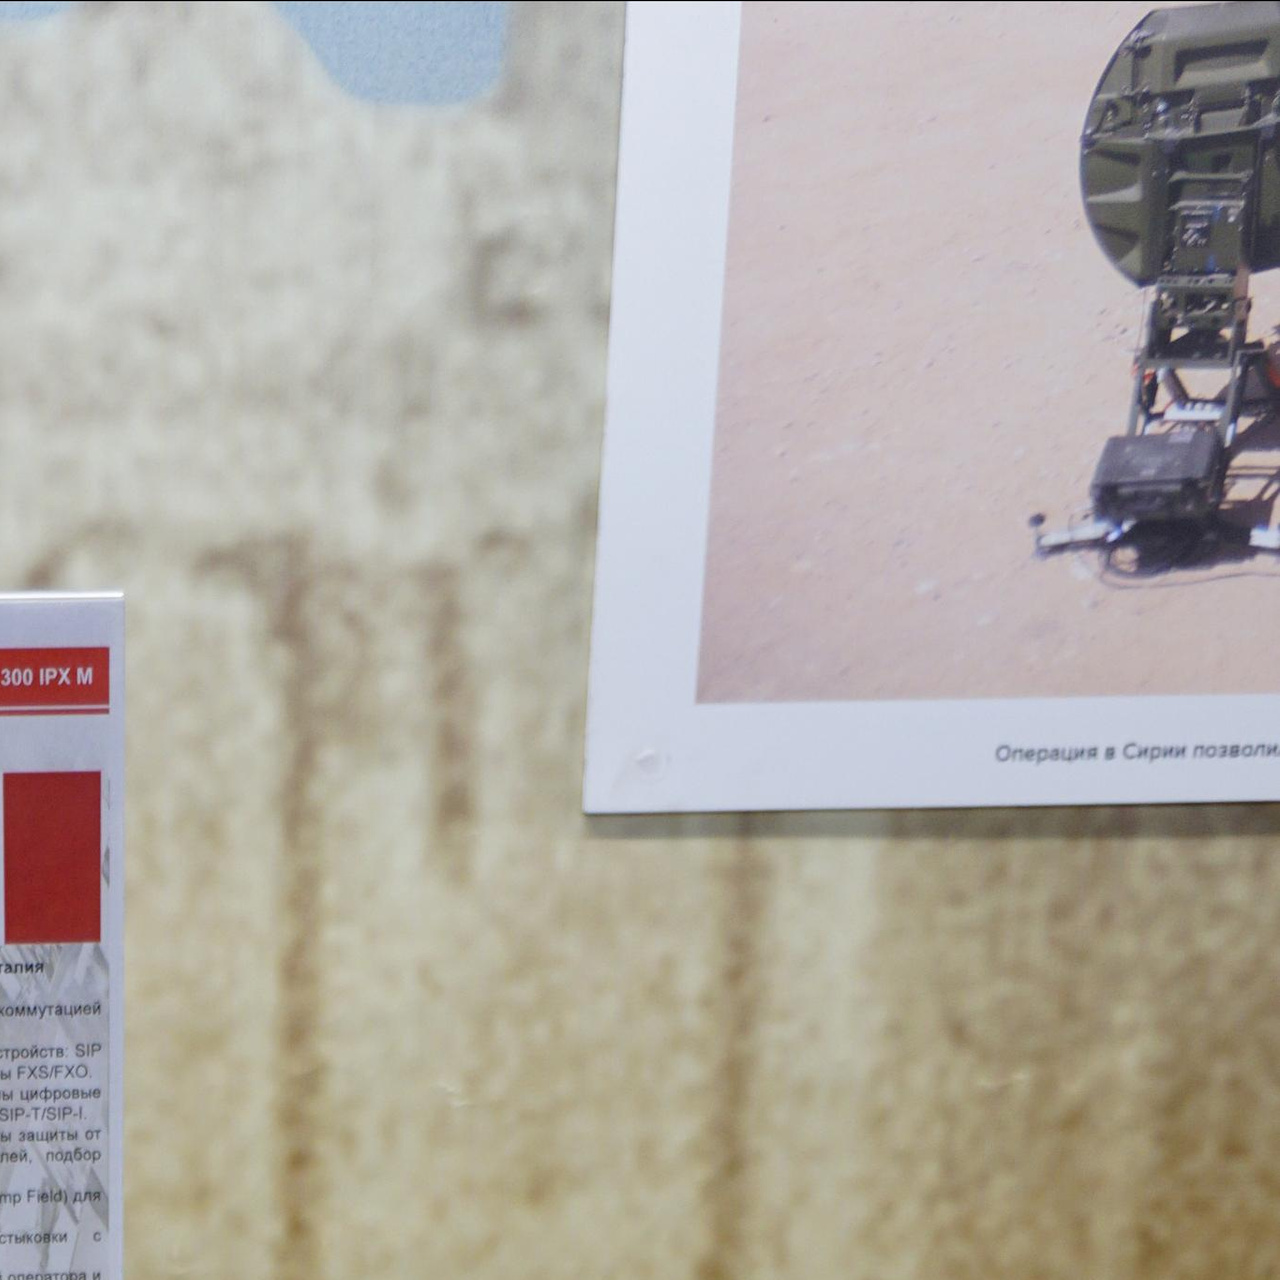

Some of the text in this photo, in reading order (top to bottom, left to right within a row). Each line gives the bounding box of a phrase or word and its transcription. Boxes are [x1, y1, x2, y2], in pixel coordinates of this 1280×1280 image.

[0, 668, 33, 687] 300
[39, 668, 70, 685] IPX
[995, 742, 1280, 765] Операция в Сирии позволи
[75, 1045, 102, 1057] SIP
[17, 1065, 92, 1079] FXS/FXO.
[20, 1087, 102, 1103] цифровые
[18, 1131, 78, 1144] защиты
[84, 1130, 102, 1141] от
[45, 1149, 102, 1164] подбор
[26, 1190, 68, 1206] Field)
[72, 1191, 102, 1204] для
